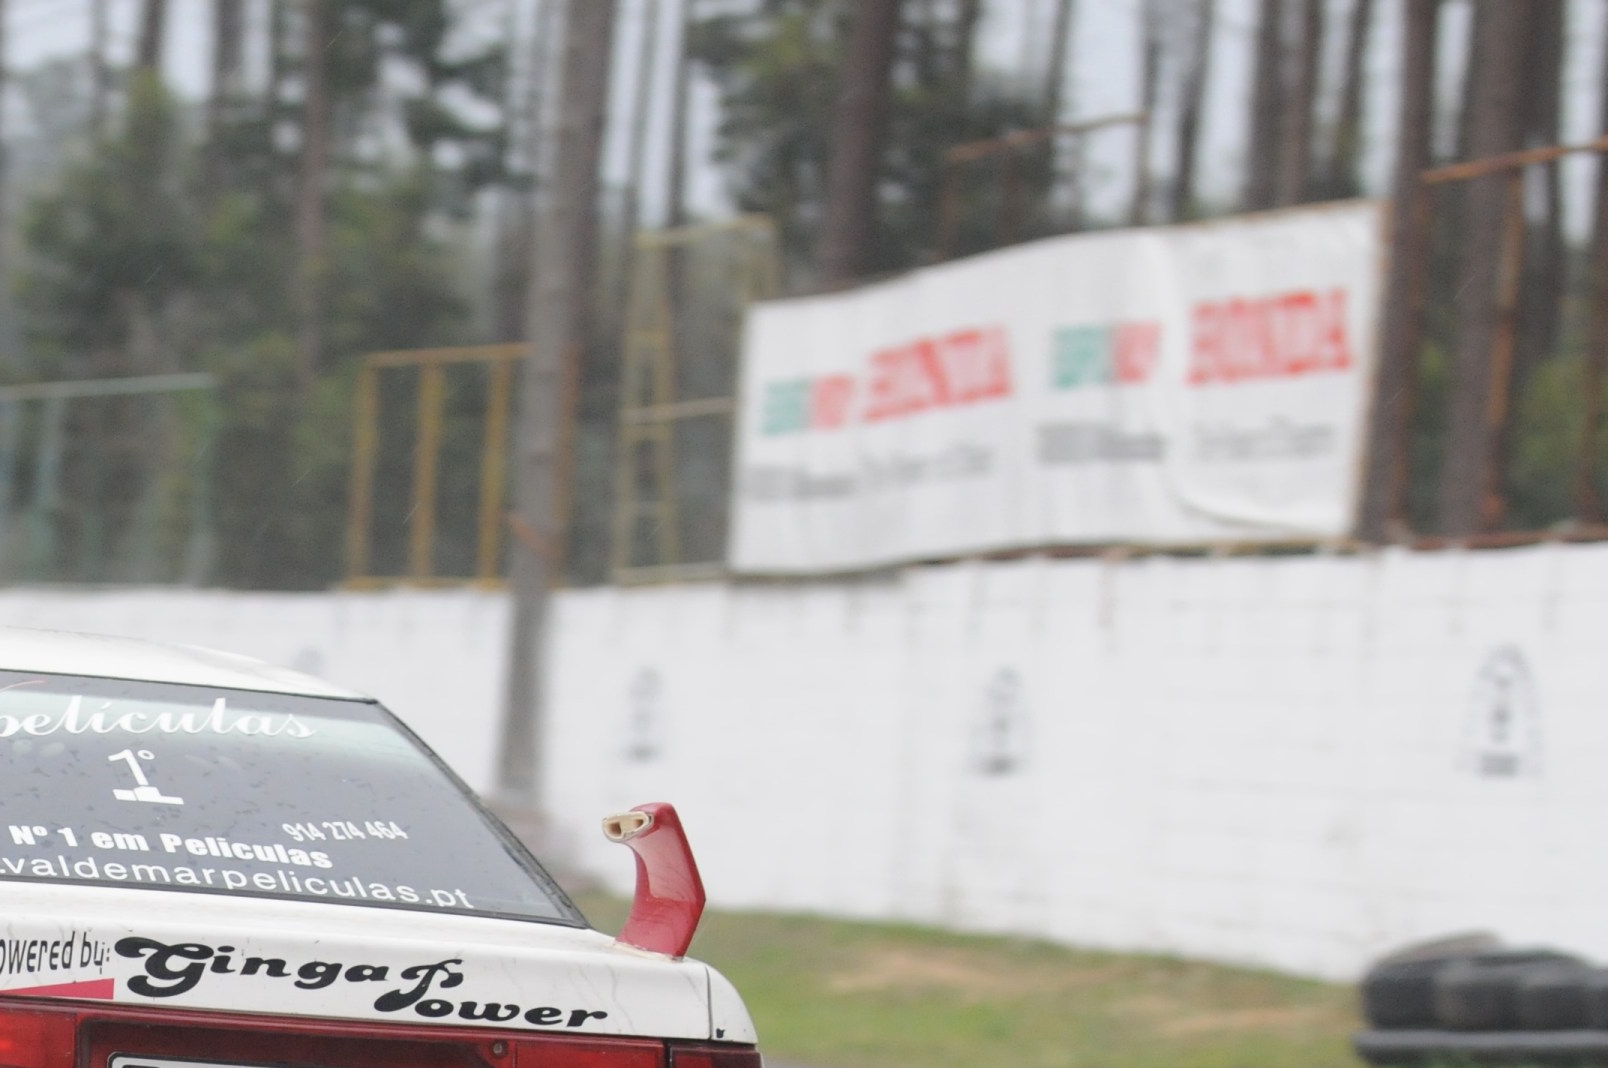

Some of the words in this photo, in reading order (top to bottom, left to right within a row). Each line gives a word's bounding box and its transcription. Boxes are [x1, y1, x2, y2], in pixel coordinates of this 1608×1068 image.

[57, 827, 78, 847] 1
[91, 831, 150, 851] em
[159, 833, 334, 869] Peliculas
[282, 822, 326, 842] 914
[322, 821, 366, 840] 274
[364, 821, 409, 840] 464
[81, 931, 111, 974] by:
[113, 936, 391, 998] Ginga
[374, 958, 609, 1028] Power
